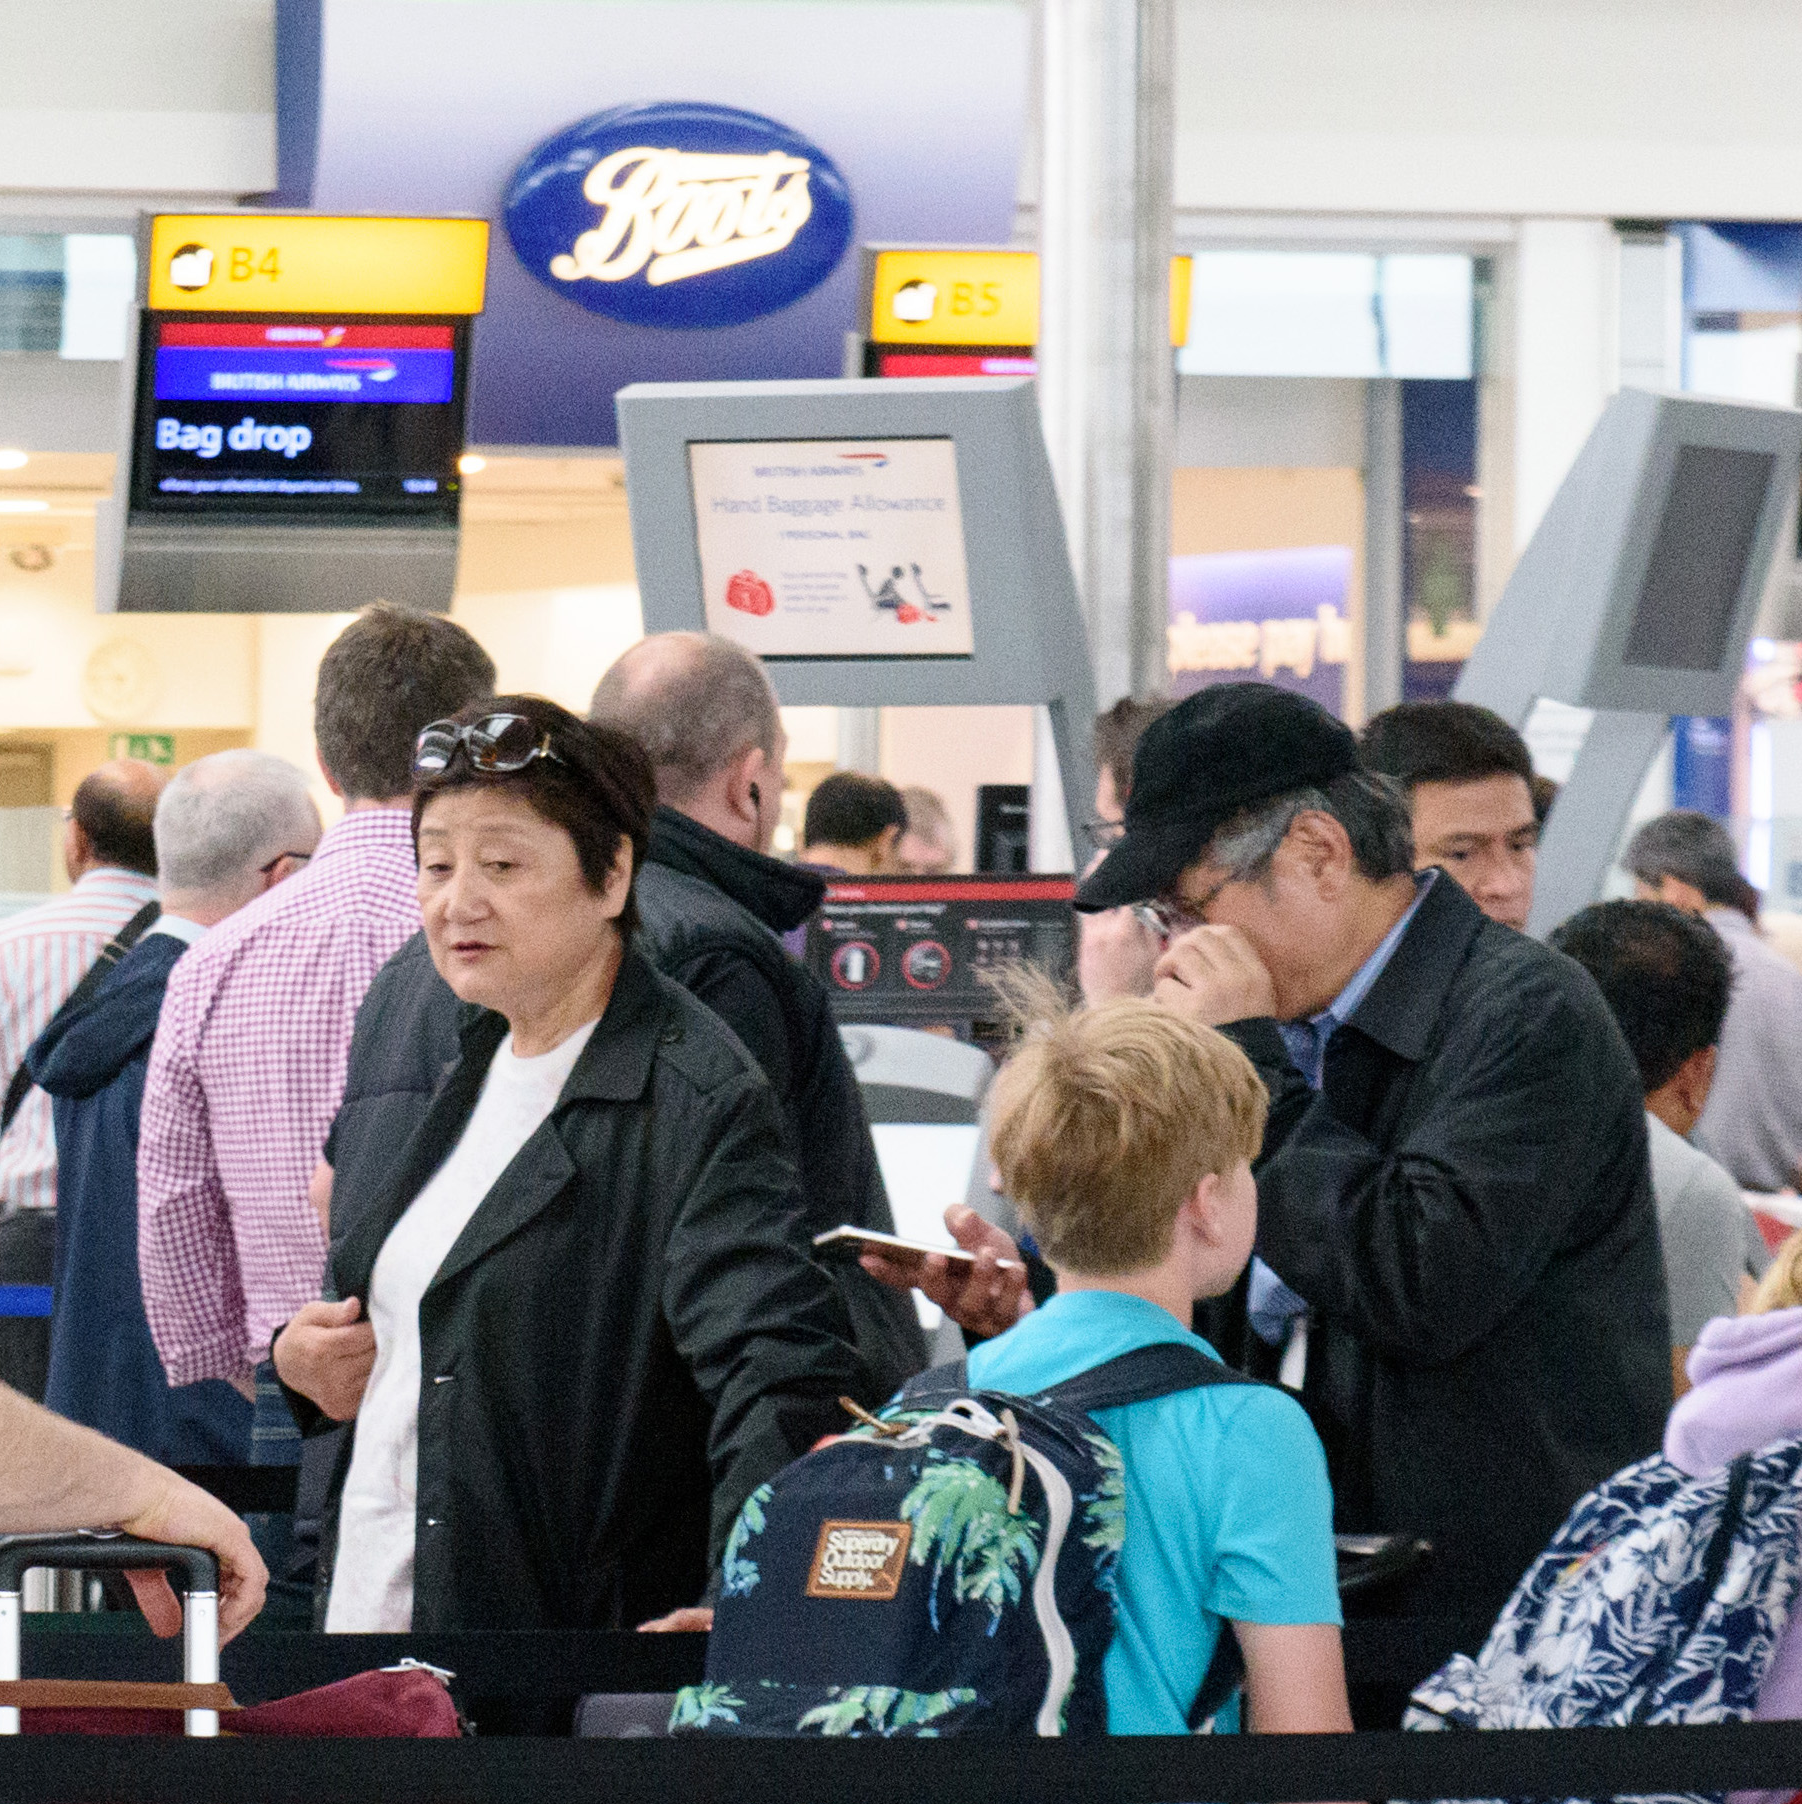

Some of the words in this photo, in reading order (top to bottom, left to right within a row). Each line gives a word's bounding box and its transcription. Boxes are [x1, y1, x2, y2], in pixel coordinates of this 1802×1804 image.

[550, 146, 812, 287] Boots
[228, 246, 282, 283] B4
[951, 281, 1003, 317] B5
[155, 417, 224, 459] Bag
[227, 416, 313, 459] drop
[821, 1549, 888, 1570] Outdoor
[827, 1530, 900, 1558] Superdry
